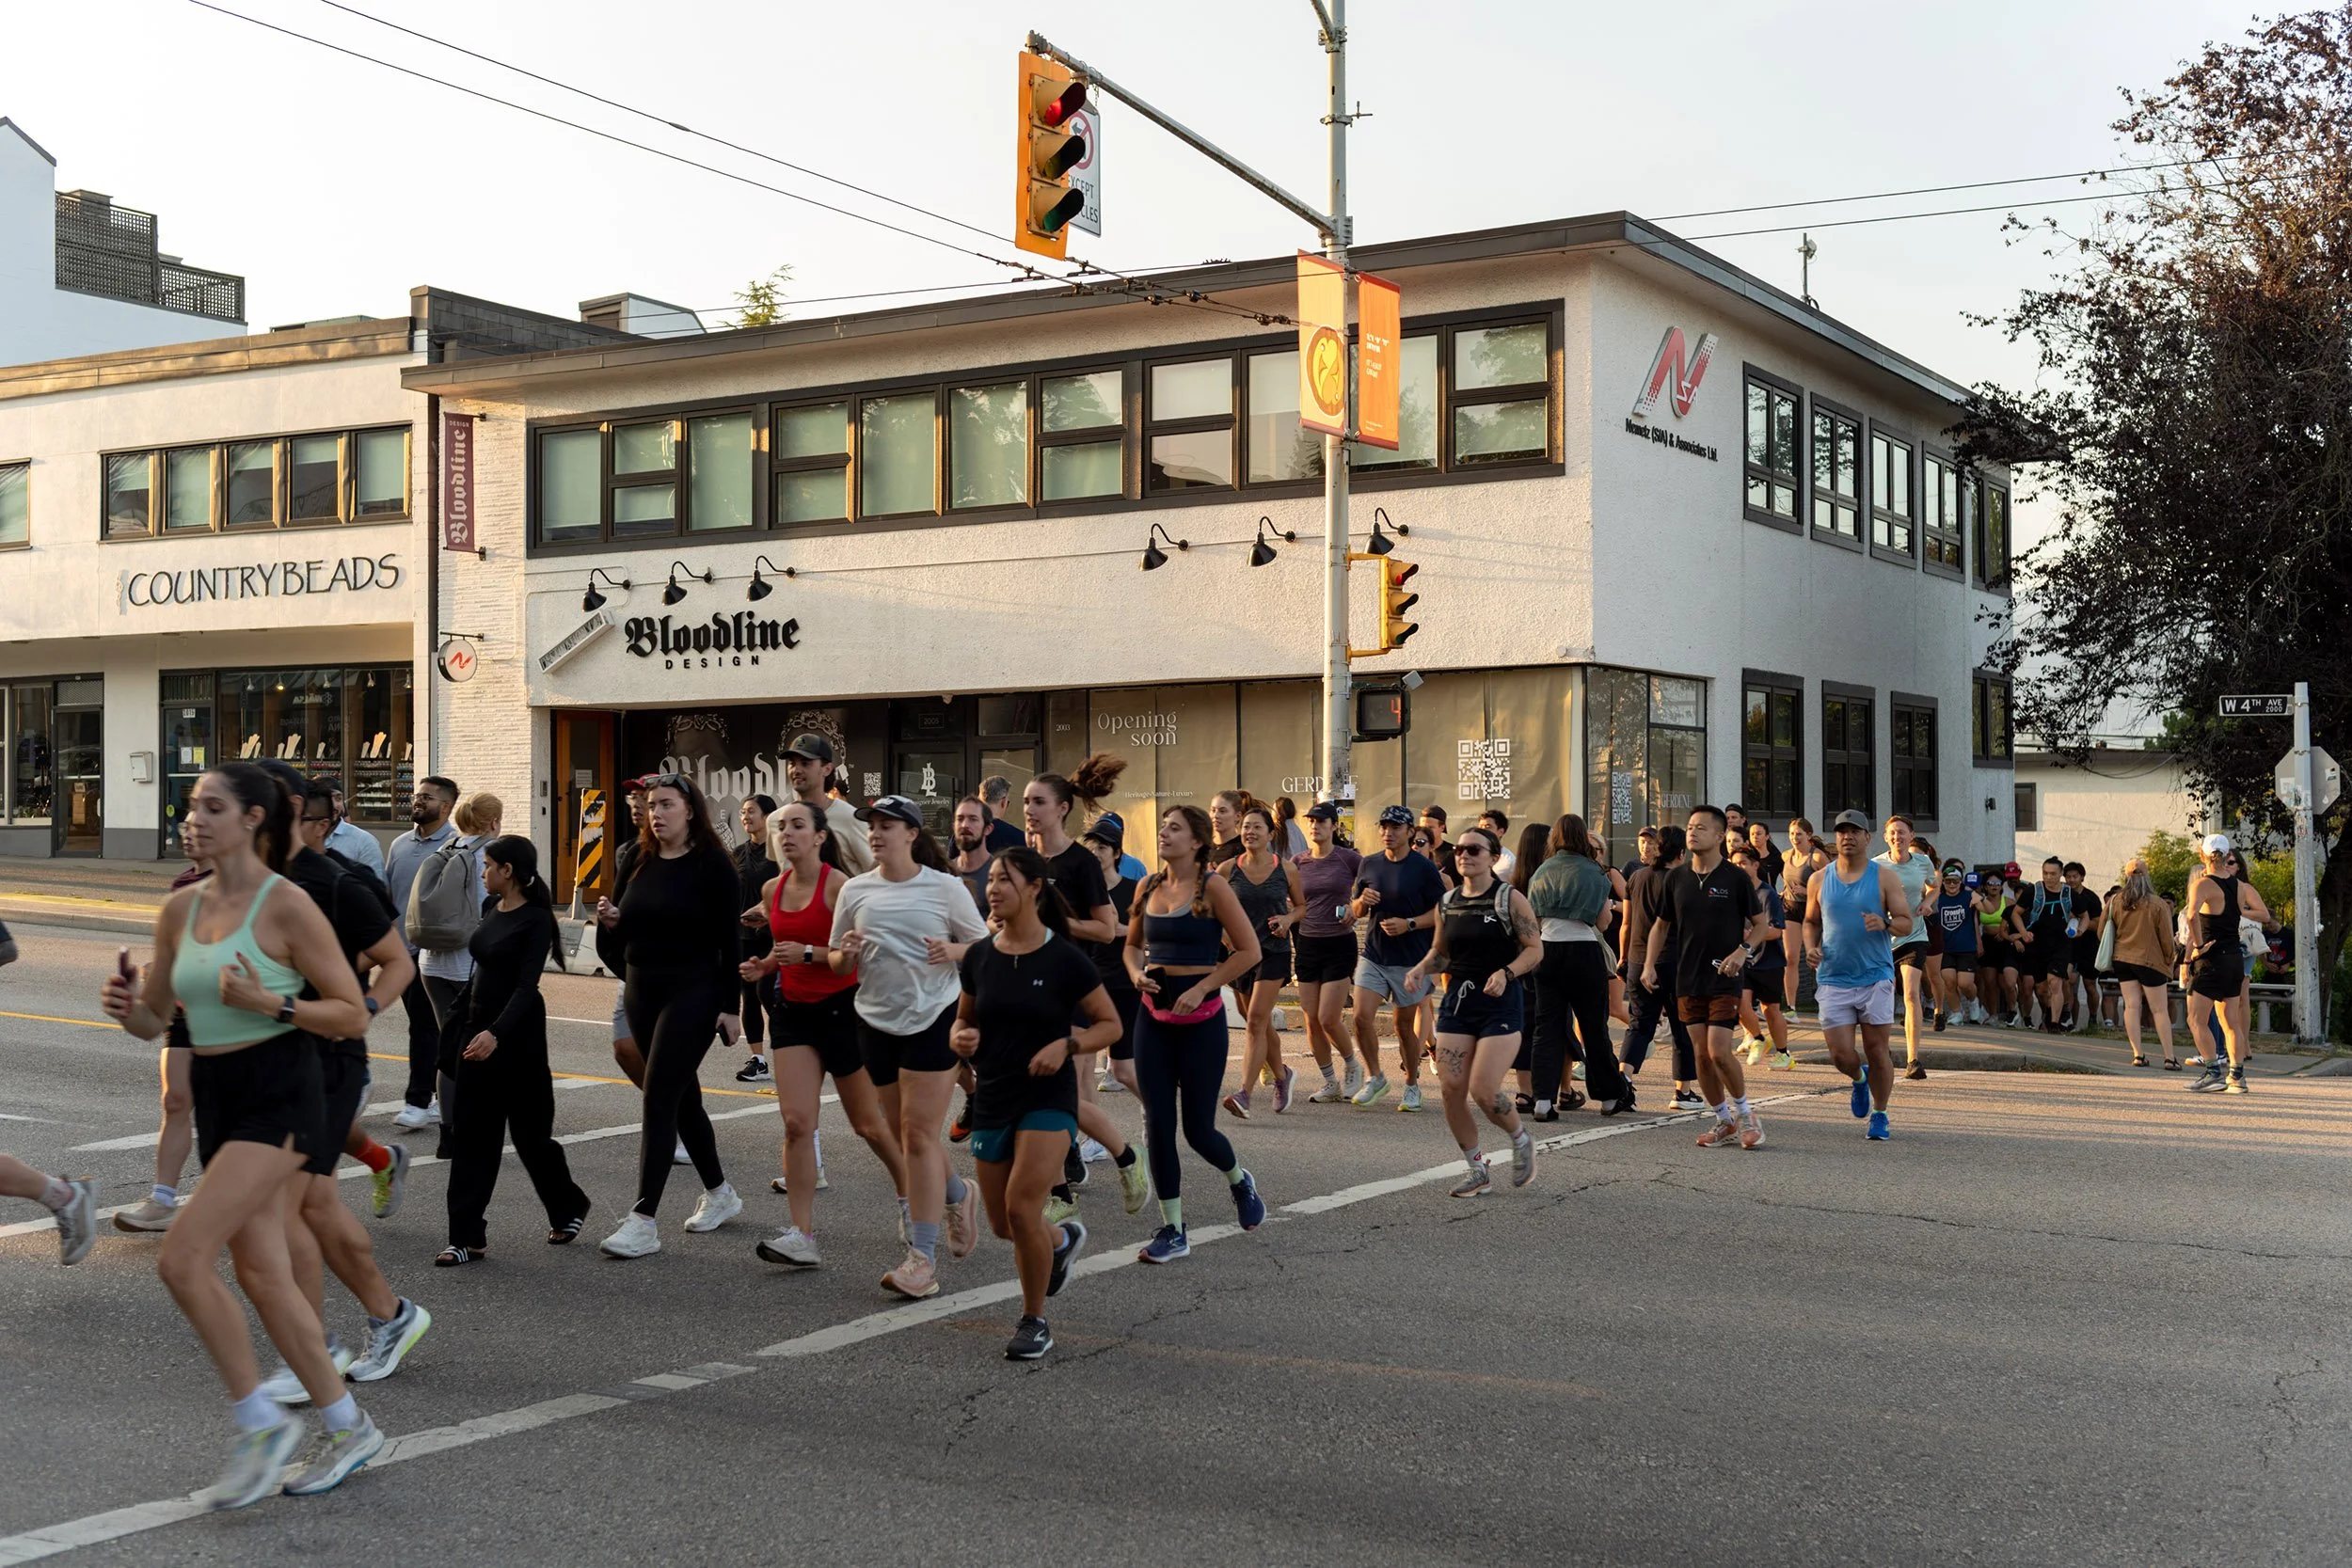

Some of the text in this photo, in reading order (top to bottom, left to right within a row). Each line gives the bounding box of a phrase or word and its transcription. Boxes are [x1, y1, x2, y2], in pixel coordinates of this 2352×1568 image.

[1676, 436, 1707, 458] Associates
[450, 428, 469, 544] Bloodline
[625, 610, 801, 657] Bloodline
[665, 655, 759, 670] DESIGN
[2225, 699, 2236, 712] W
[1056, 723, 1071, 732] 2003
[1098, 710, 1177, 735] Opening
[1131, 730, 1177, 746] soon
[1281, 775, 1359, 793] GERDE
